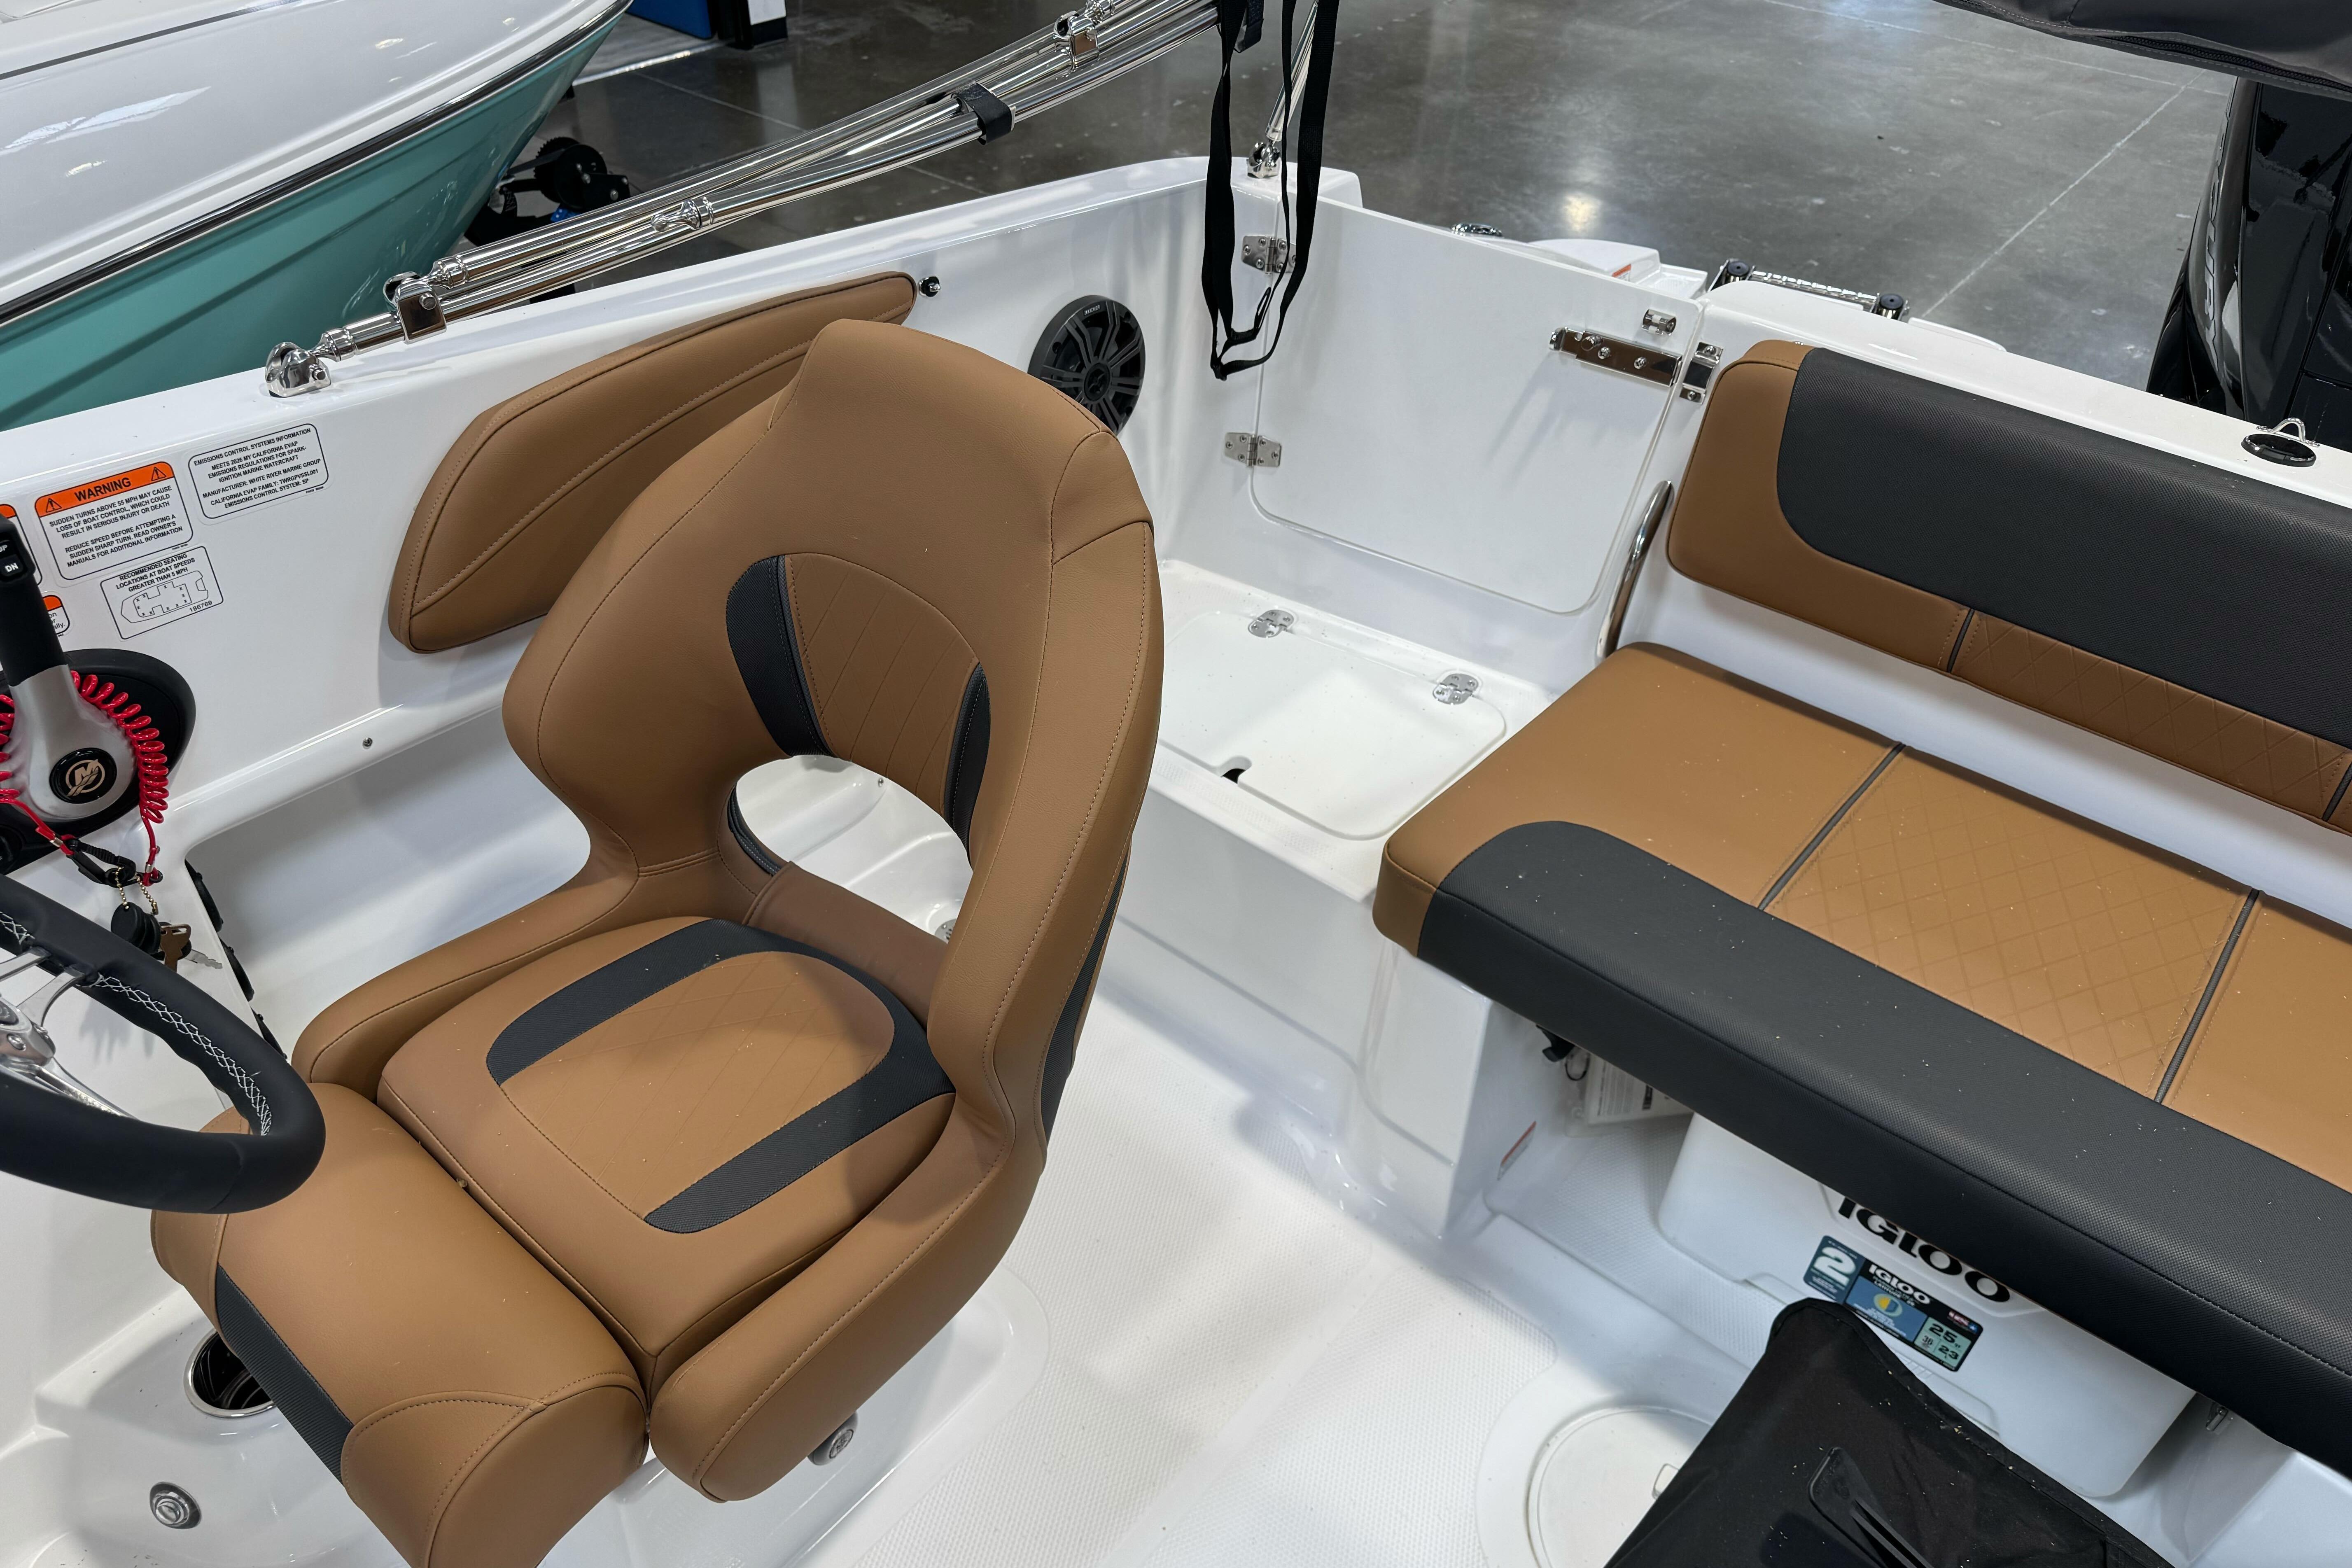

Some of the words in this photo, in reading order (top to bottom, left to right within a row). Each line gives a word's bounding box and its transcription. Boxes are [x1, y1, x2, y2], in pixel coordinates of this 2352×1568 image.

[194, 453, 223, 466] EMISSIONS
[224, 446, 250, 457] CONTROL
[250, 438, 275, 449] SYSTEMS
[275, 428, 310, 442] INFORMATION
[211, 461, 230, 470] MEETS
[252, 445, 284, 458] CALIFORNIA
[284, 441, 298, 449] EVAP
[203, 481, 248, 498] MANUFACTURER:
[248, 475, 265, 484] WHITE
[266, 470, 282, 478] RIVER
[282, 464, 302, 474] MARINE
[303, 458, 320, 467] GROUP
[208, 466, 237, 478] EMISSIONS
[238, 455, 275, 469] REGULATIONS
[219, 471, 242, 482] IGNITION
[243, 465, 263, 475] MARINE
[263, 455, 298, 469] WATERCRAFT
[74, 477, 131, 501] WARNING
[210, 492, 243, 505] CALIFORNIA
[258, 481, 278, 490] FAMILY:
[224, 495, 253, 508] EMISSIONS
[254, 488, 278, 499] CONTROL
[279, 481, 301, 491] SYSTEM:
[49, 515, 74, 527] SUDDEN
[75, 509, 95, 518] TURNS
[96, 502, 117, 513] ABOVE
[138, 491, 150, 499] MAY
[152, 485, 172, 495] CAUSE
[56, 523, 72, 532] LOSS
[82, 515, 99, 524] BOAT
[100, 506, 130, 518] CONTROL,
[130, 499, 149, 509] WHICH
[150, 493, 170, 503] COULD
[61, 527, 84, 538] RESULT
[93, 516, 119, 528] SERIOUS
[119, 510, 139, 520] INJURY
[150, 501, 170, 511] DEATH
[65, 541, 90, 553] REDUCE
[90, 534, 110, 544] SPEED
[110, 527, 134, 538] BEFORE
[135, 516, 170, 531] ATTEMPTING
[67, 554, 96, 567] MANUALS
[110, 539, 144, 553] ADDITIONAL
[145, 526, 182, 542] INFORMATION
[69, 547, 94, 559] SUDDEN
[94, 540, 114, 551] SHARP
[115, 535, 133, 544] TURN.
[133, 530, 149, 538] READ
[150, 521, 176, 533] OWNER'S
[5, 562, 19, 572] DN
[116, 574, 148, 589] LOCATIONS
[157, 565, 172, 574] BOAT
[173, 558, 195, 569] SPEEDS
[119, 562, 163, 581] RECOMMENDED
[163, 553, 187, 565] SEATING
[128, 579, 155, 592] GREATER
[155, 573, 170, 582] THAN
[1084, 1128, 1100, 1139] KICKER
[1838, 1197, 2010, 1302] IGLOO
[1813, 1246, 1856, 1286] 2
[1869, 1264, 1931, 1304] IGLOO
[1929, 1323, 1958, 1343] 25
[1938, 1345, 1959, 1360] 23
